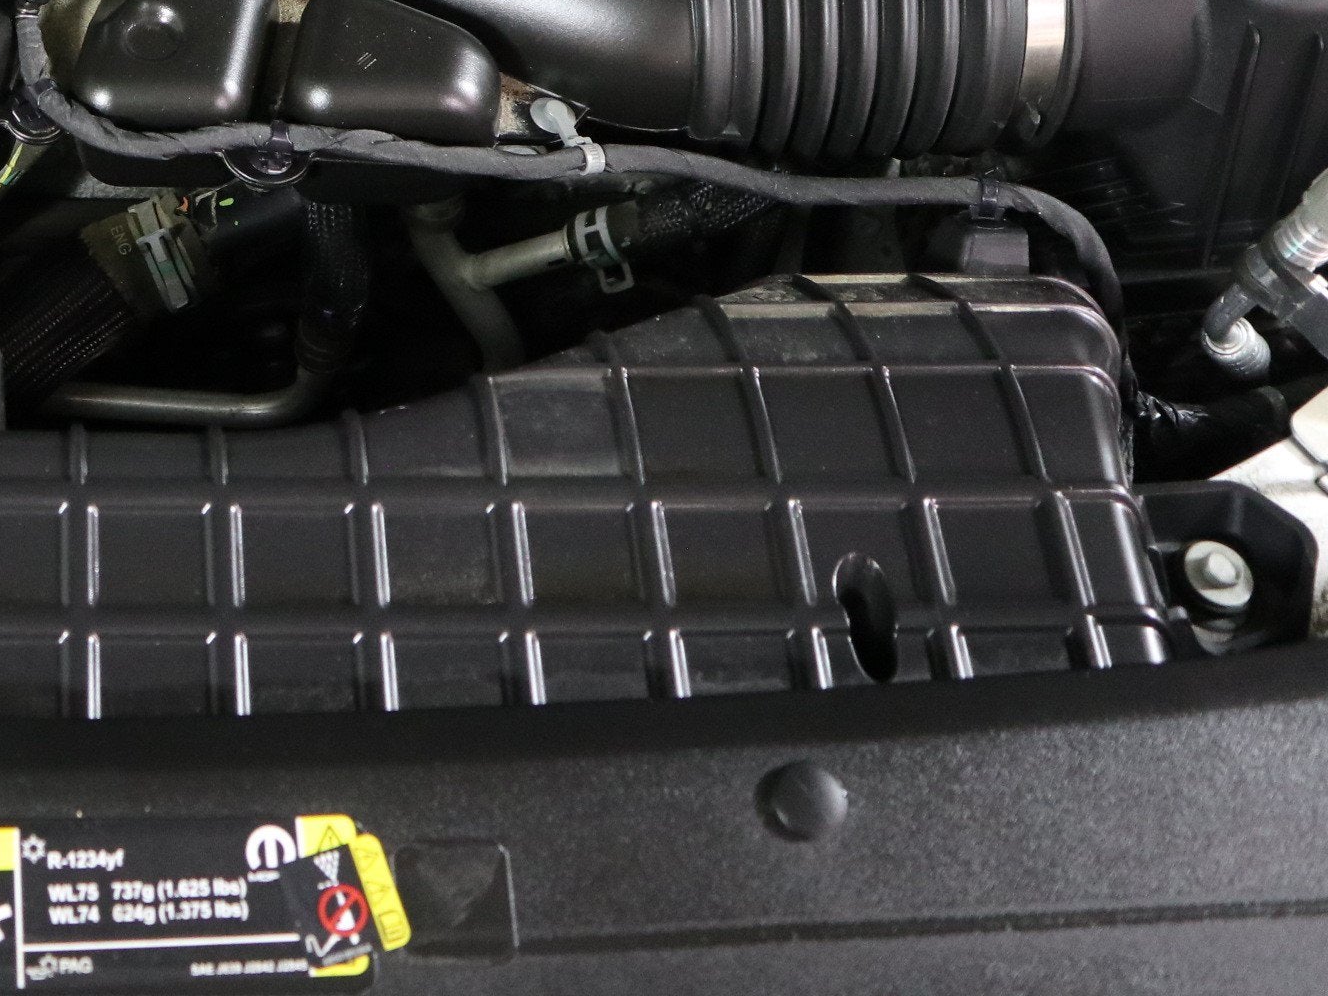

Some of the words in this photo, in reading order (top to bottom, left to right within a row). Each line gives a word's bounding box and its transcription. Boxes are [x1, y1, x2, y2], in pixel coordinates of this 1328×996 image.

[110, 224, 133, 256] ENG
[47, 848, 124, 871] R-1234yf
[47, 882, 100, 902] WL75
[111, 880, 155, 903] 737g
[213, 876, 247, 899] lbs)
[48, 904, 101, 925] WL74
[213, 899, 249, 921] lbs)
